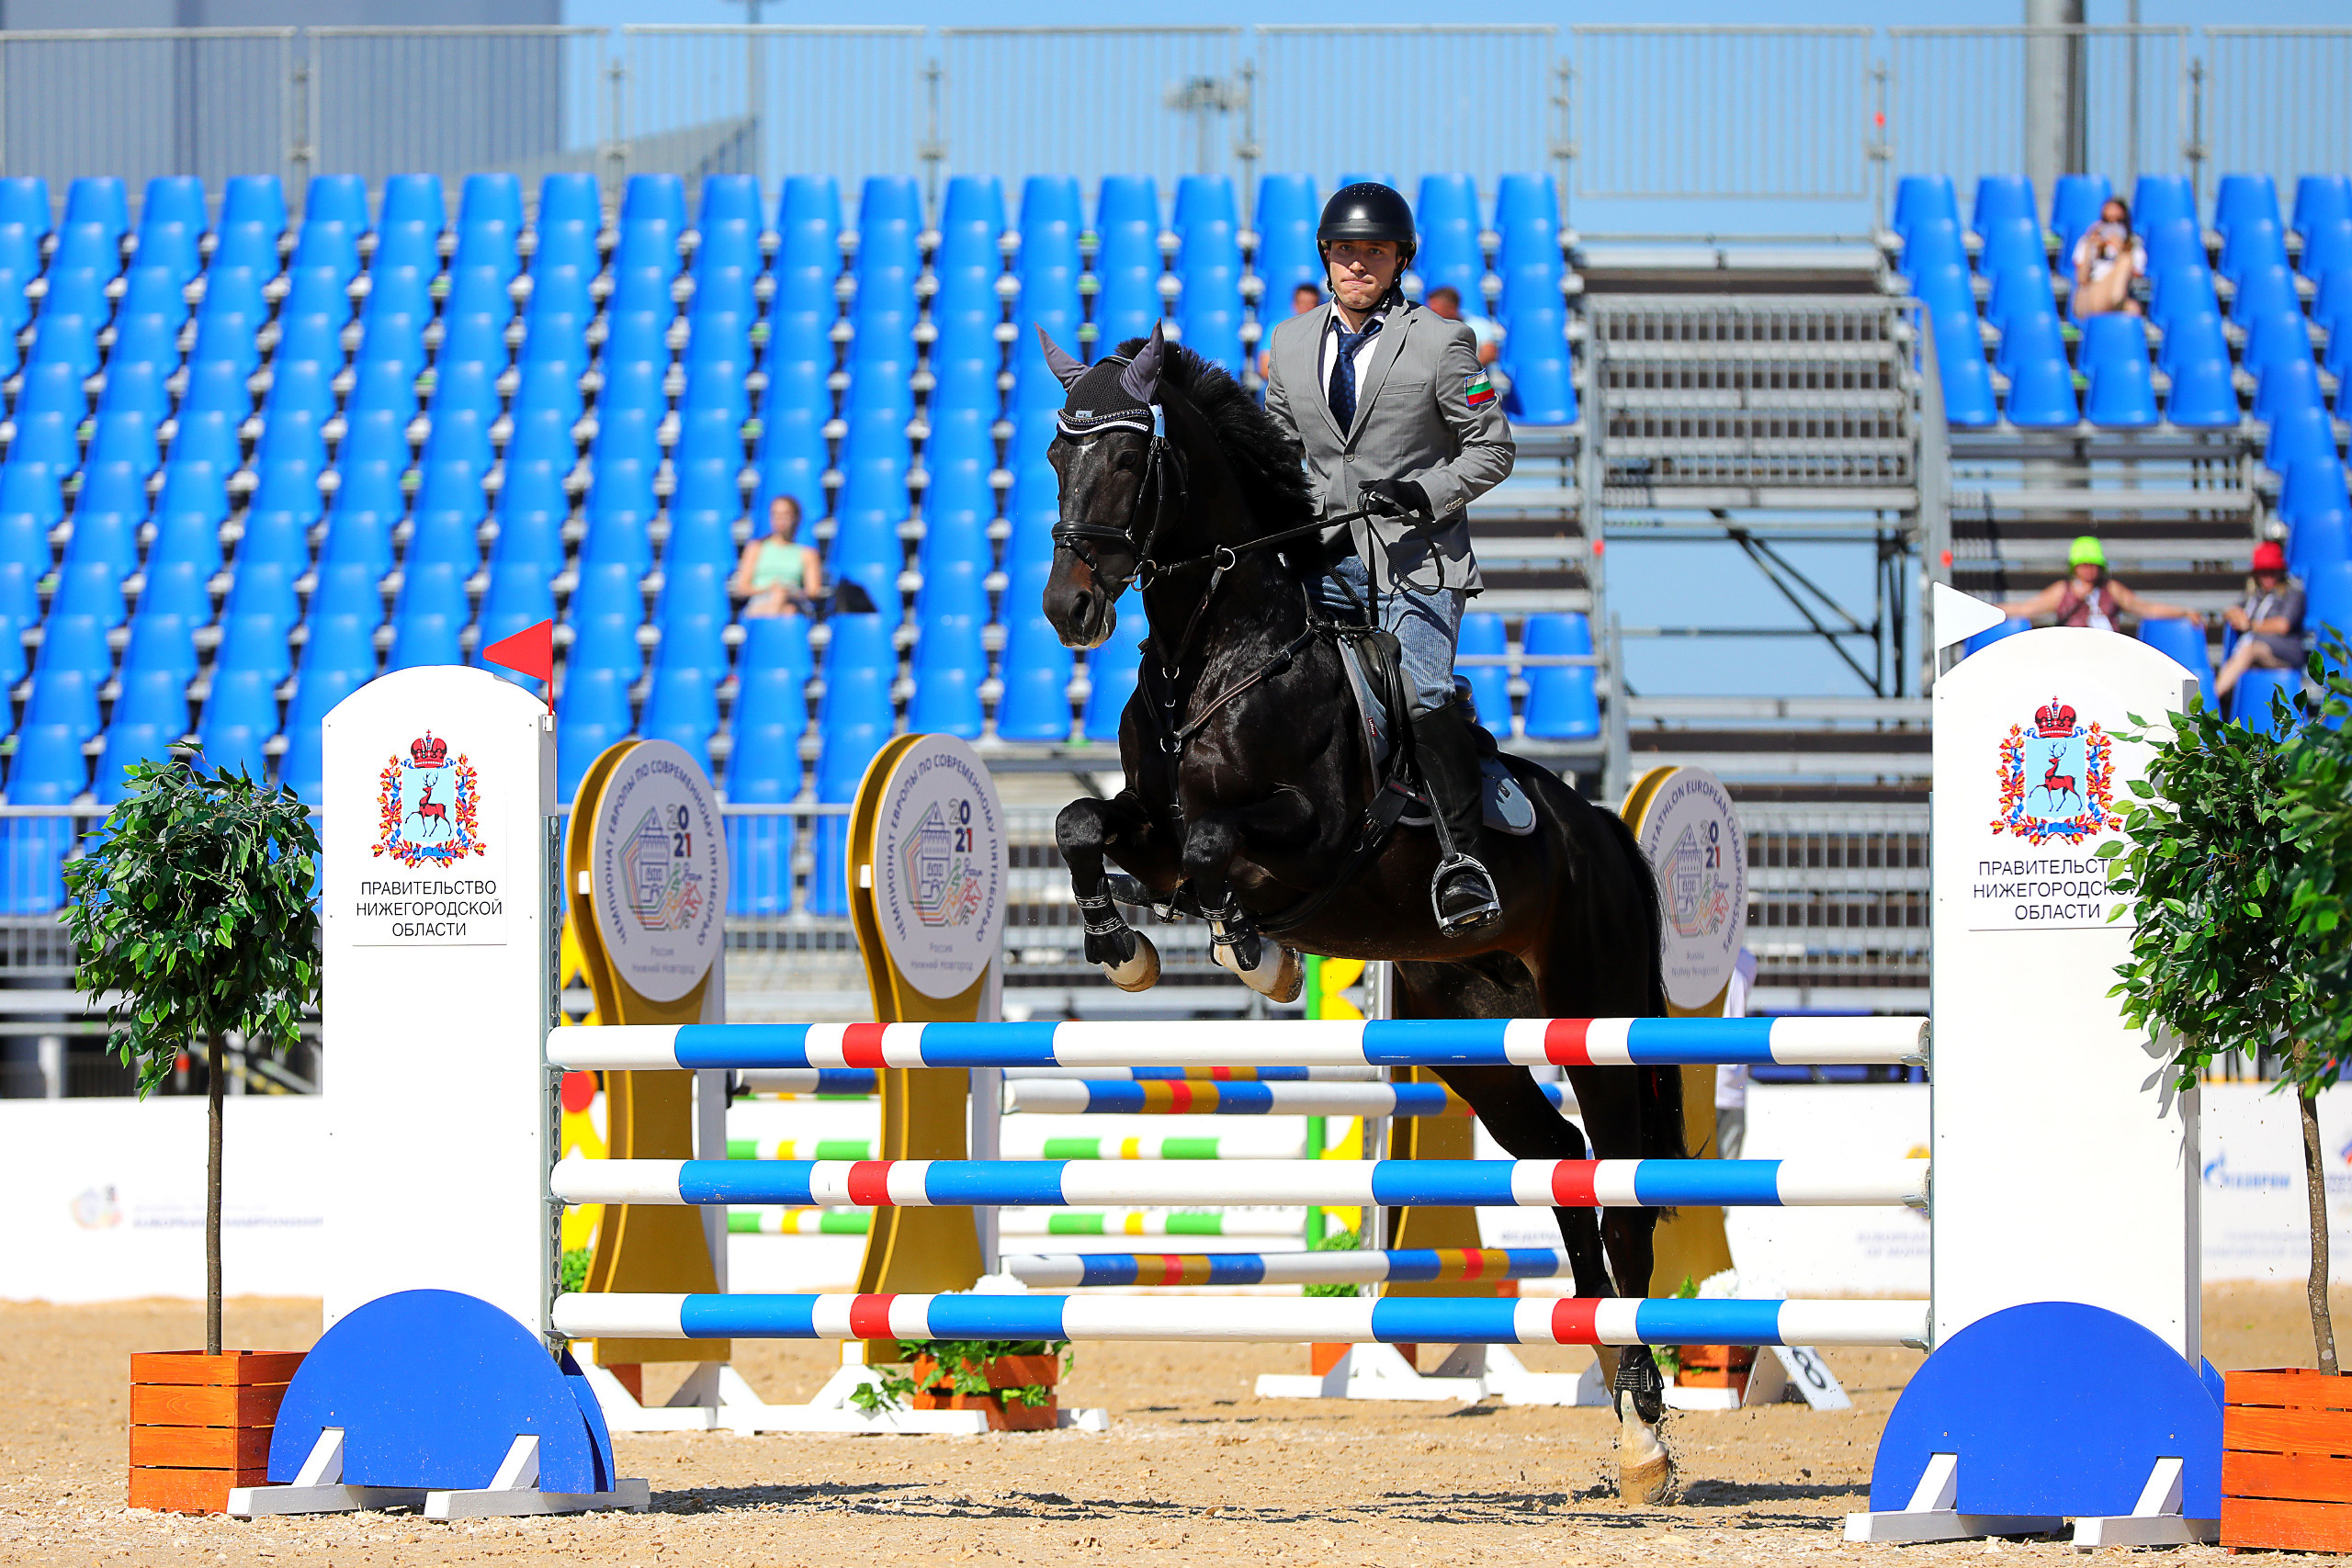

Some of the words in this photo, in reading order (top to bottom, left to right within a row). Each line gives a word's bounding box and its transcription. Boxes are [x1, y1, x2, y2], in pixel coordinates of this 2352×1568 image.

[635, 762, 650, 781] ПО
[918, 757, 933, 774] ПО
[891, 769, 919, 829] ЕВРОПЫ
[933, 753, 995, 833] СОВРЕМЕННОМУ
[665, 803, 690, 830] 20
[948, 797, 971, 826] 20
[956, 827, 973, 852] 21
[1699, 818, 1720, 844] 20
[673, 831, 692, 858] 21
[1705, 845, 1721, 869] 21
[1686, 779, 1729, 817] EUROPEAN
[1723, 816, 1743, 953] CHAMPIONSHIPS
[1978, 858, 2133, 876] ПРАВИТЕЛЬСТ
[360, 880, 497, 896] ПРАВИТЕЛЬСТВО
[887, 834, 907, 942] ЧЕМПИОНАТ
[356, 897, 503, 918] НИЖЕГОРОДСКОЙ
[2014, 903, 2101, 921] ОБЛАСТИ
[391, 921, 467, 937] ОБЛАСТИ
